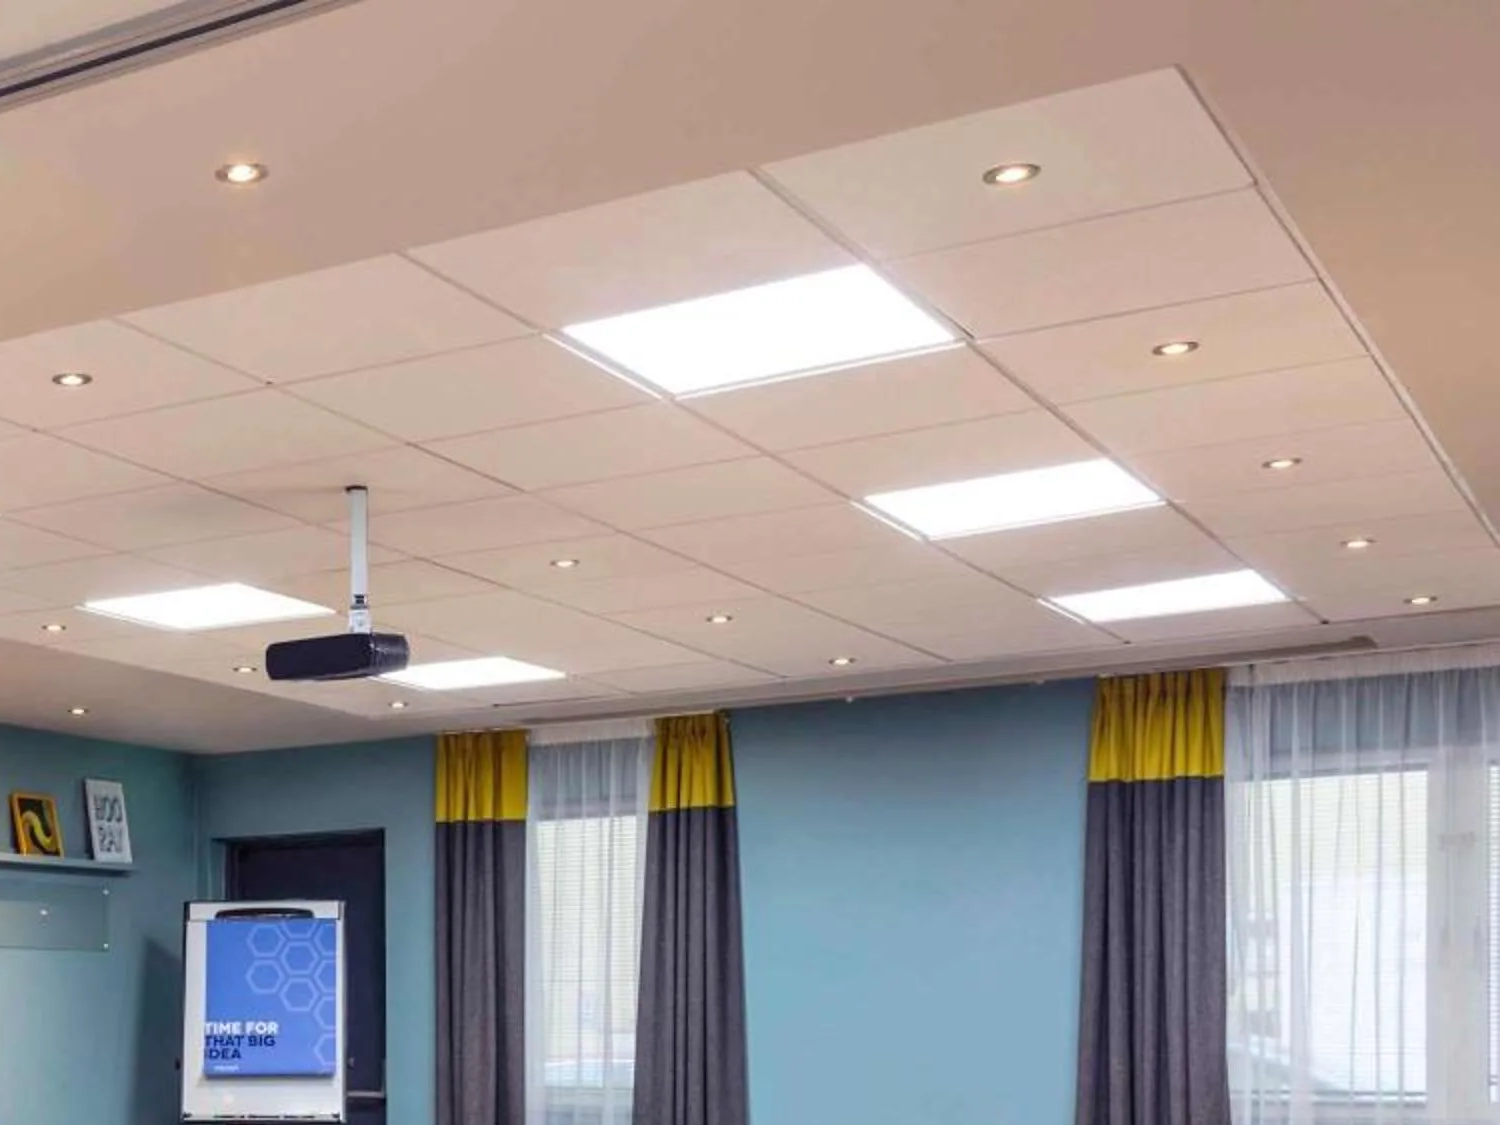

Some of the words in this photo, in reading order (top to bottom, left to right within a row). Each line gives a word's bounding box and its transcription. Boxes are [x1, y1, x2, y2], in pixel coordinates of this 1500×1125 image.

[205, 1022, 241, 1035] TIME
[246, 1022, 279, 1035] FOR
[205, 1035, 244, 1047] THAT
[248, 1035, 276, 1047] BIG
[204, 1048, 242, 1060] DEA
